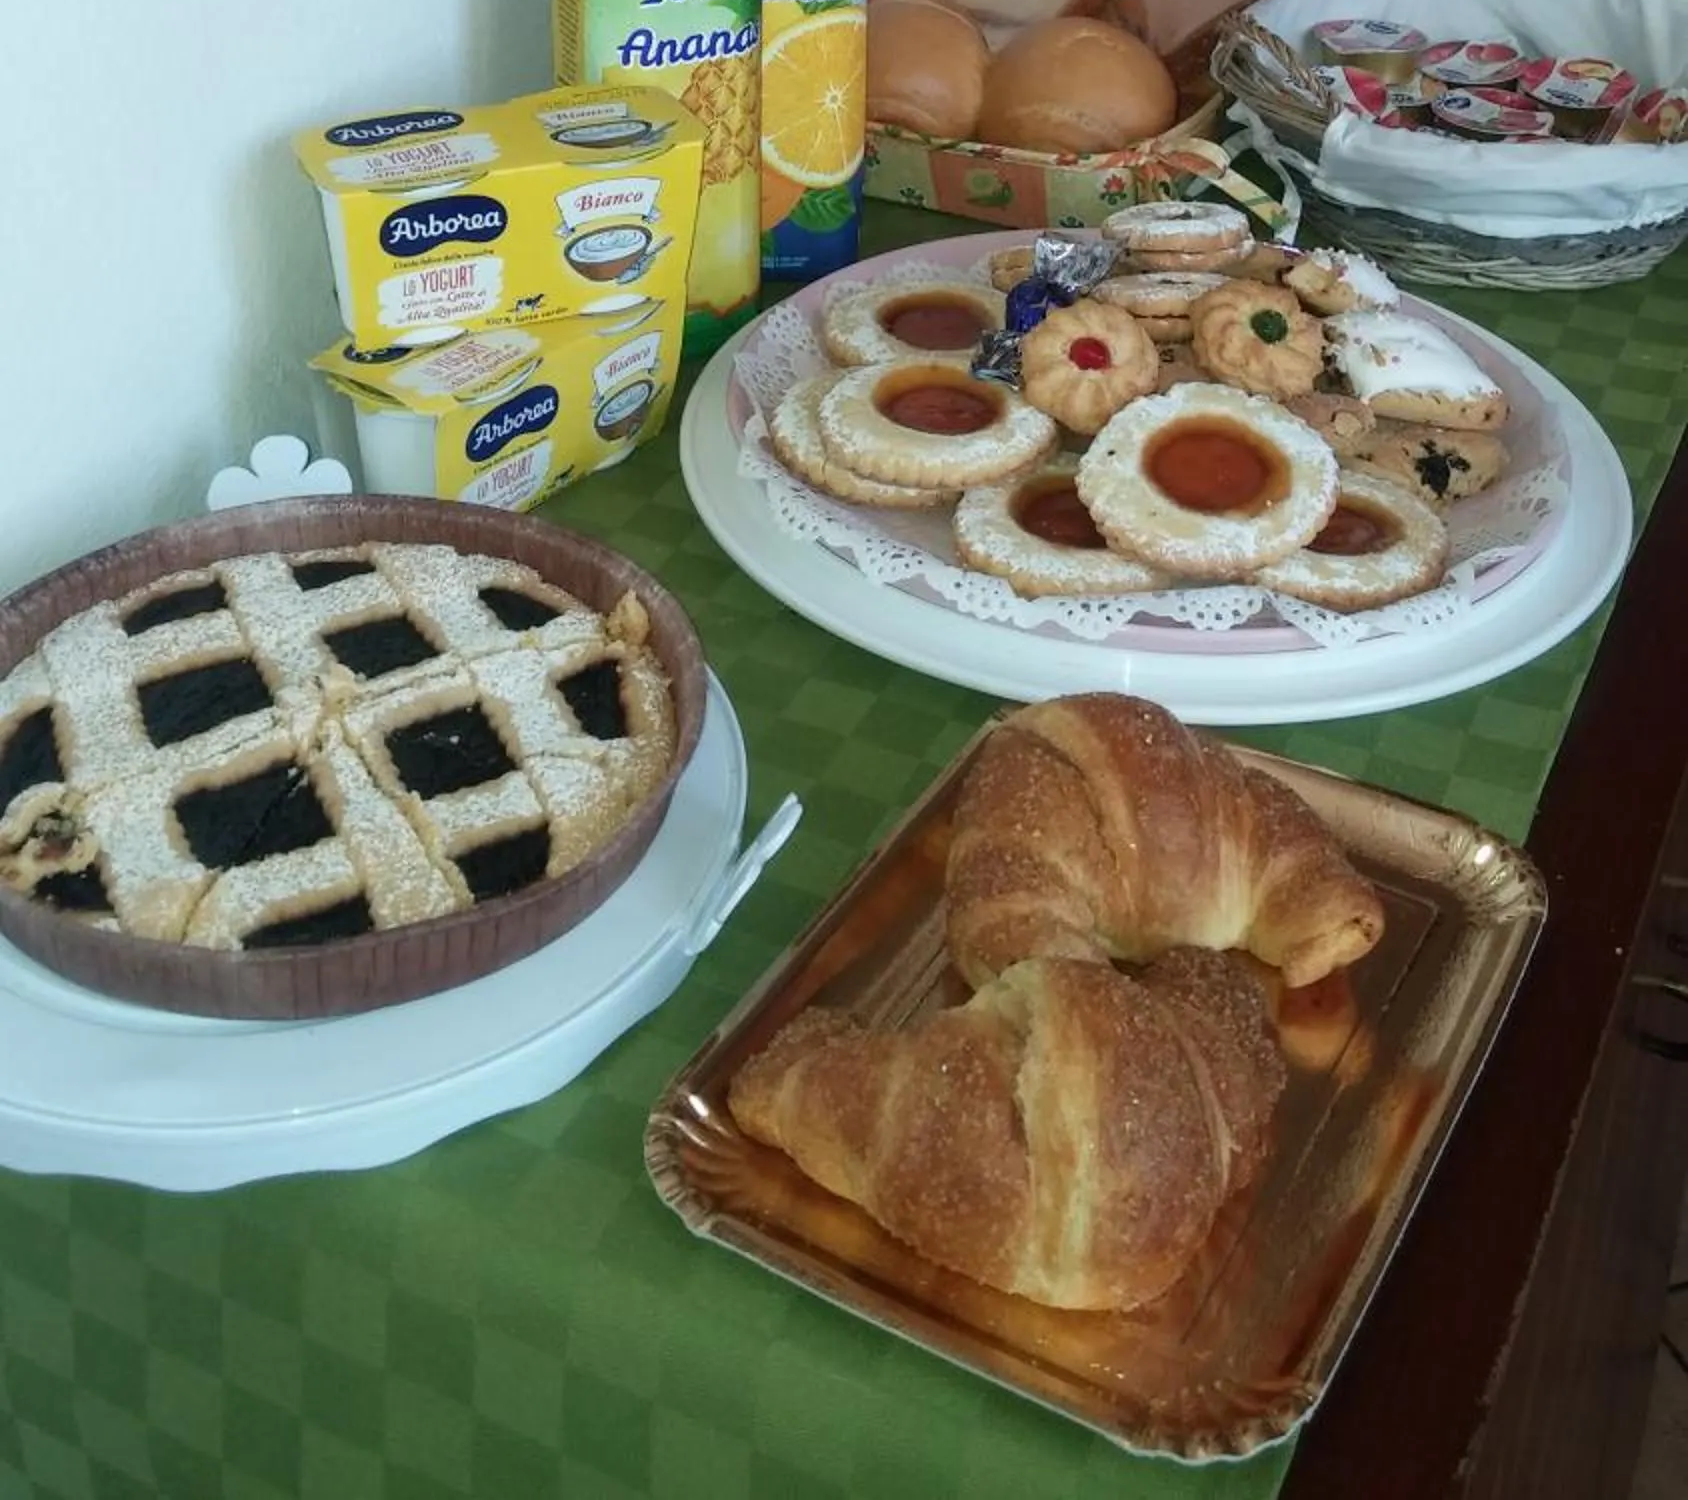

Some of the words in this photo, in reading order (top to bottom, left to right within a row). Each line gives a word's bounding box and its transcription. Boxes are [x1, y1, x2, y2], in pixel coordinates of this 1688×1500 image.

[616, 20, 760, 68] Anana
[334, 114, 457, 141] Arborea
[576, 189, 644, 212] Bianco
[389, 211, 504, 244] Arborea
[420, 262, 477, 295] YOGURT
[472, 396, 555, 451] Arborea
